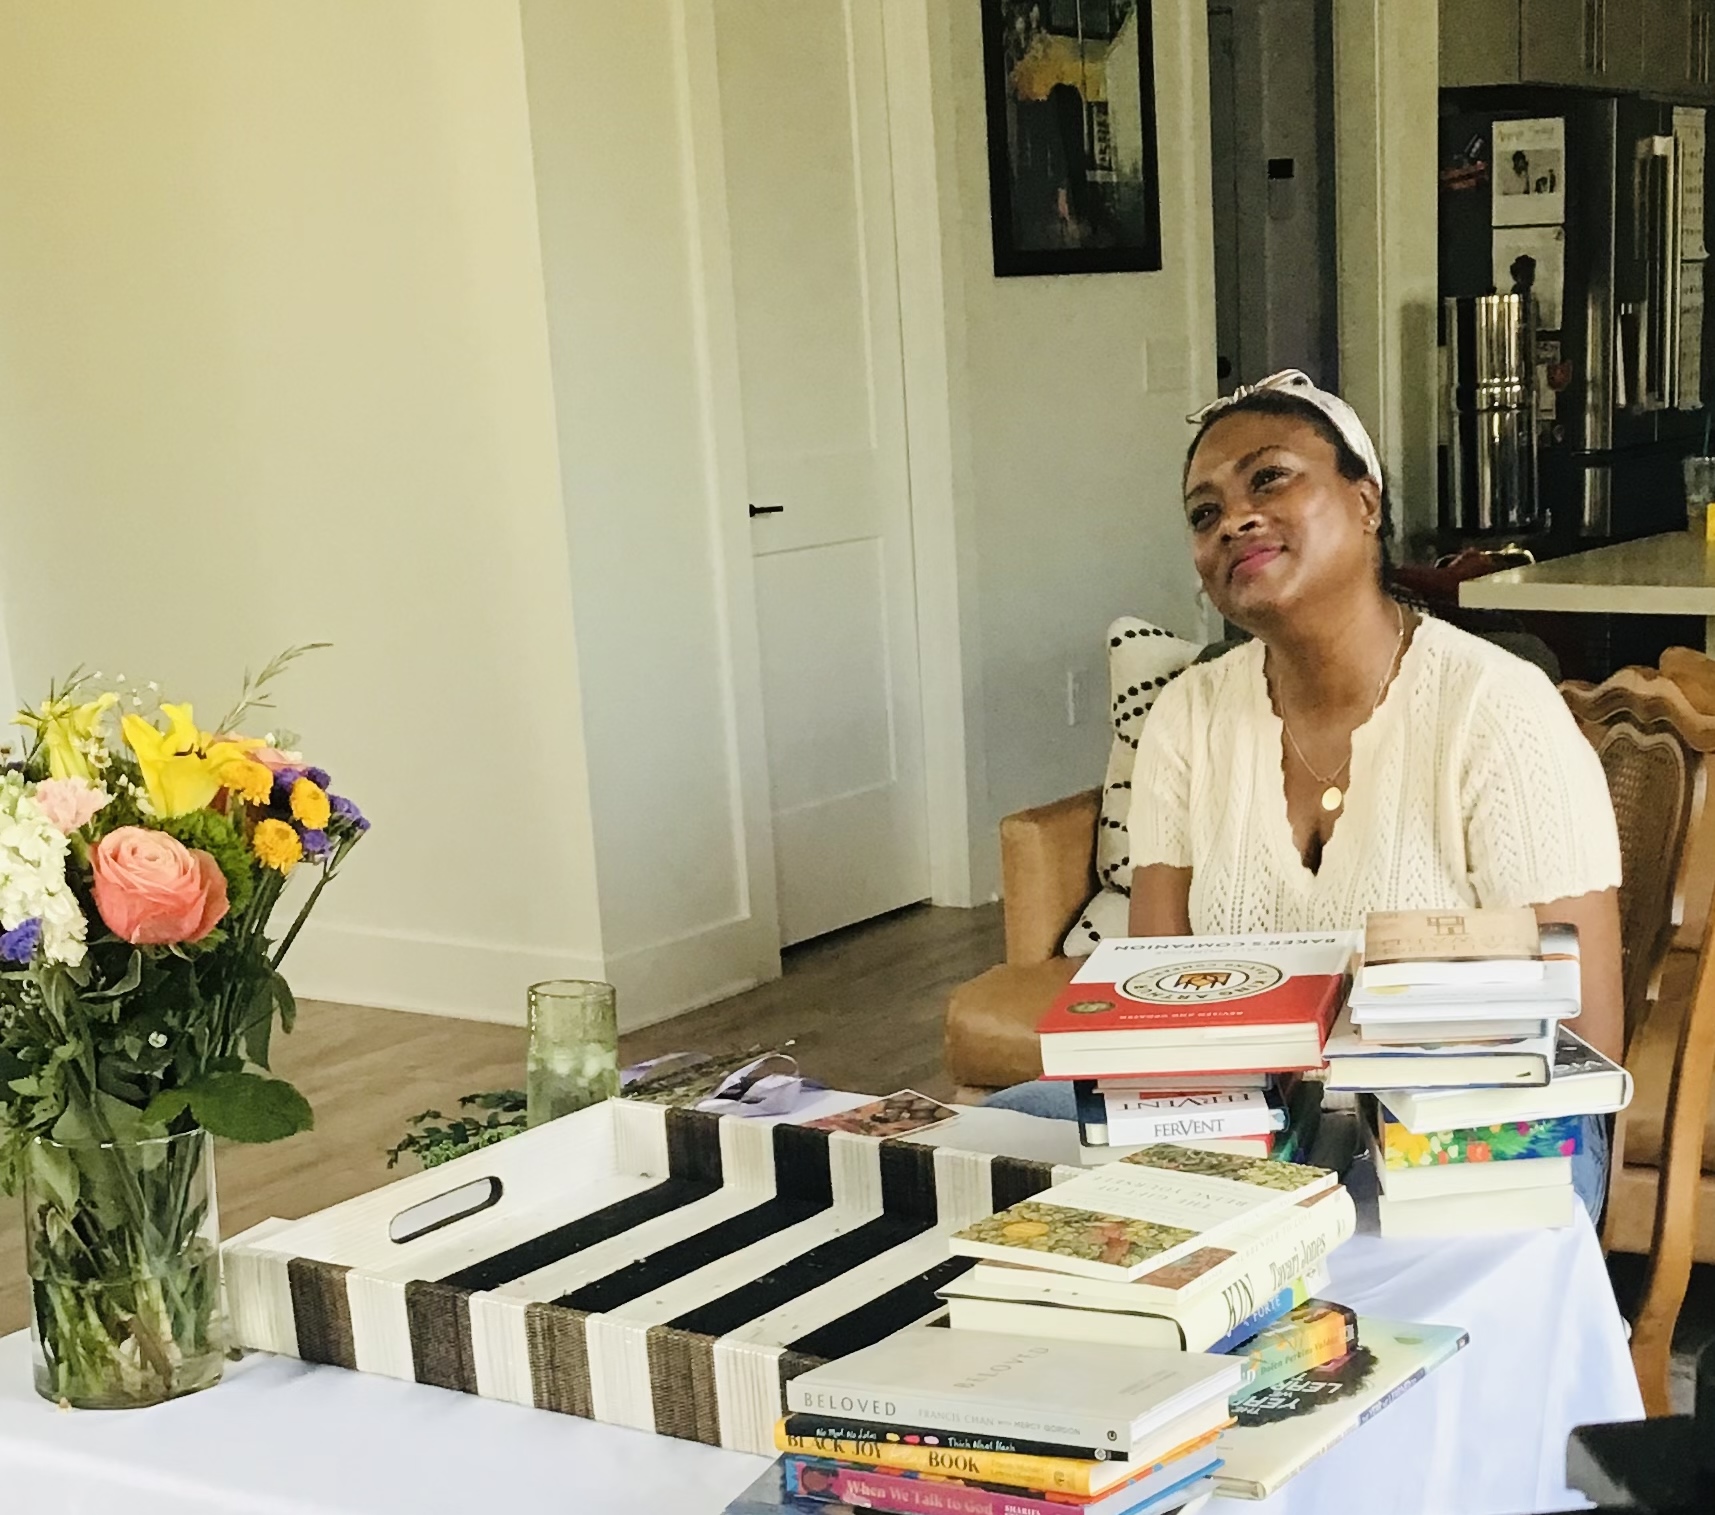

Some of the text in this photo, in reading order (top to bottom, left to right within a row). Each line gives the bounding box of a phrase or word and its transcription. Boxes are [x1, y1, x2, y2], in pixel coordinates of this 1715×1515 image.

[1113, 937, 1337, 951] BAKER'S COMPANION
[1132, 980, 1266, 1000] KING ARTHUR
[1153, 1118, 1225, 1138] FERVENT
[1301, 1232, 1327, 1269] Jones
[953, 1346, 1049, 1389] BELOVED
[1270, 1380, 1344, 1394] LEAR
[804, 1392, 897, 1417] BELOVED
[917, 1408, 961, 1423] FRANCIS
[964, 1412, 994, 1427] CHAN
[1013, 1420, 1041, 1431] MERCY
[815, 1427, 827, 1437] No
[846, 1429, 857, 1439] No
[787, 1434, 846, 1454] BLACK
[851, 1439, 883, 1459] JOY
[928, 1451, 981, 1475] BOOK
[845, 1479, 994, 1515] When We Talk to God
